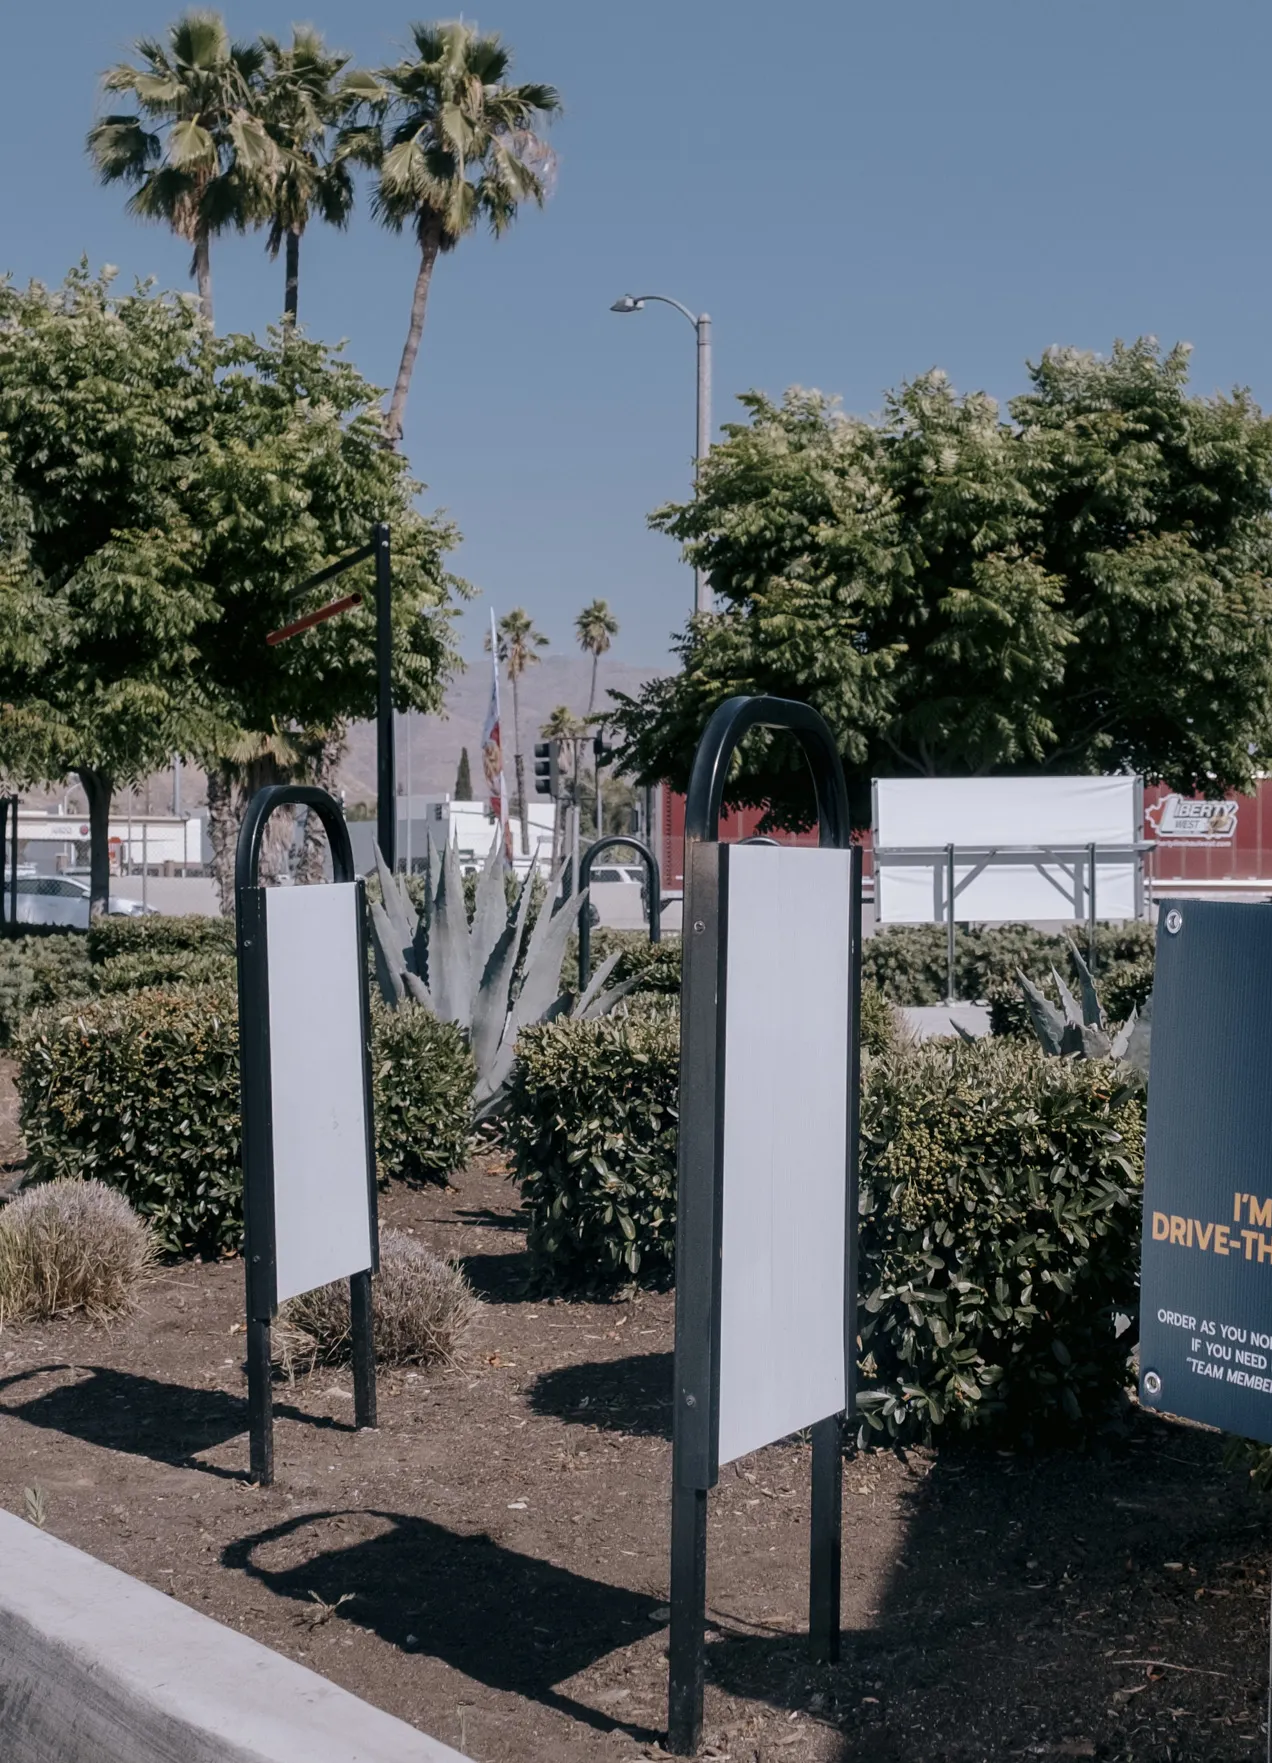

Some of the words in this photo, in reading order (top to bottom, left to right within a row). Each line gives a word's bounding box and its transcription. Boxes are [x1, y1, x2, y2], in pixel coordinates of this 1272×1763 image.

[1233, 1192, 1272, 1228] I'M
[1157, 1309, 1196, 1330] ORDER
[1200, 1320, 1215, 1335] AS
[1220, 1324, 1246, 1343] YOU
[1191, 1338, 1201, 1352] IF
[1206, 1342, 1231, 1360] YOU
[1235, 1349, 1267, 1370] NEED
